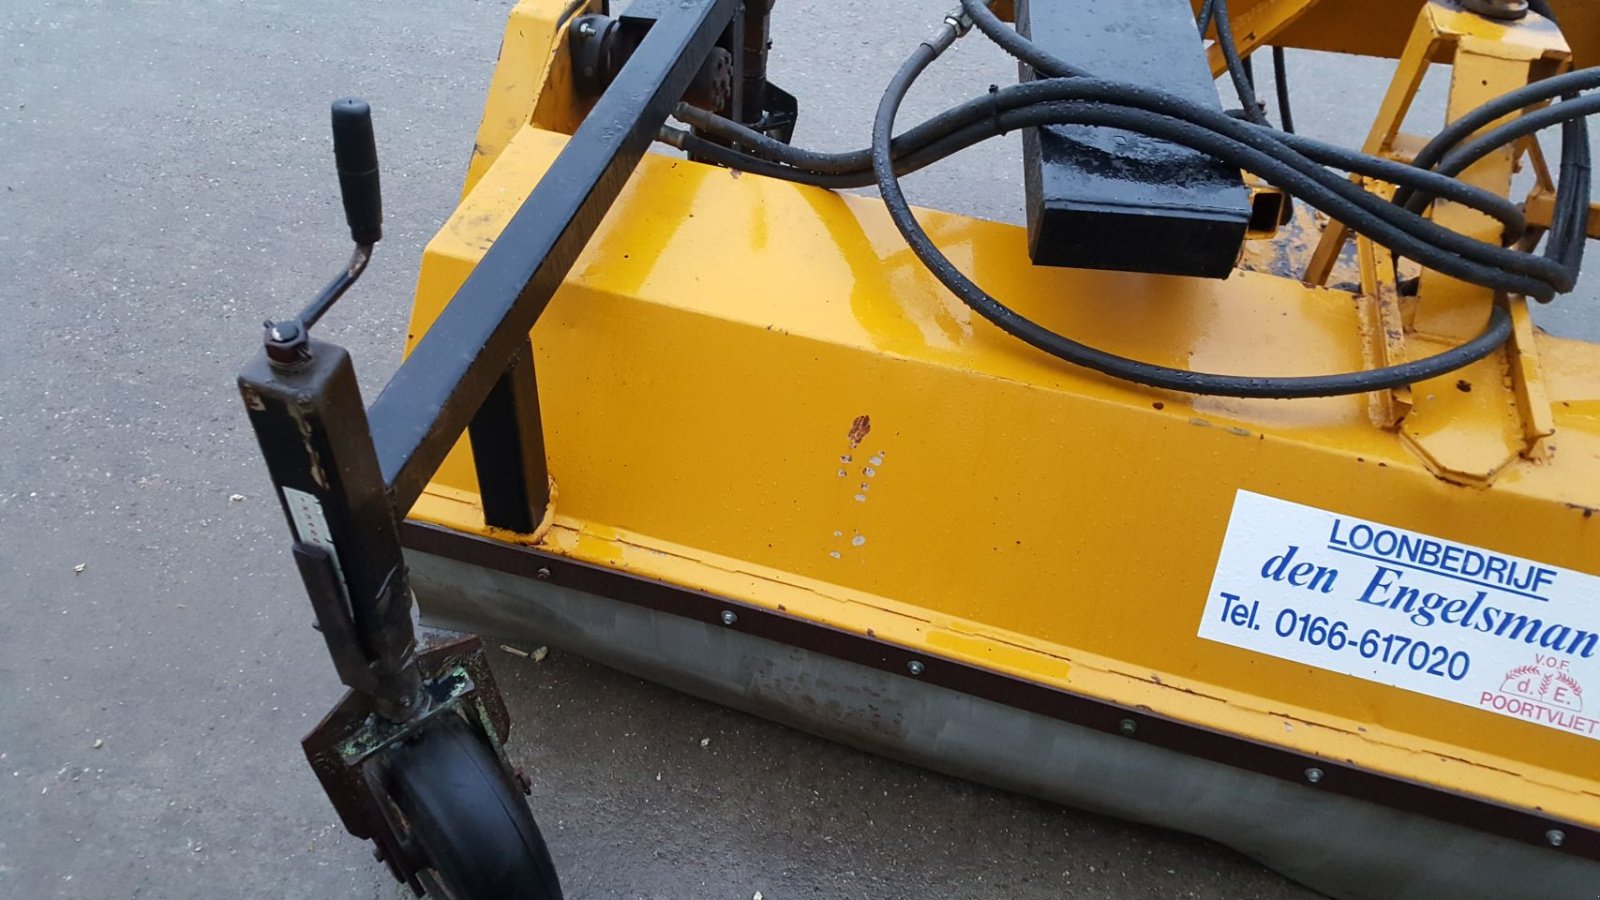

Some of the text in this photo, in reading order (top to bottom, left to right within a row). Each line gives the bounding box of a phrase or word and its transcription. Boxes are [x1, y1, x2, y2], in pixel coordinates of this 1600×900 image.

[1329, 519, 1557, 592] LOONBEDRIJF
[1219, 591, 1471, 681] Tel. 0166-617020
[1261, 545, 1599, 659] den Engelsman
[1535, 653, 1570, 673] V.O.F.
[1480, 691, 1600, 734] POORTVLIET
